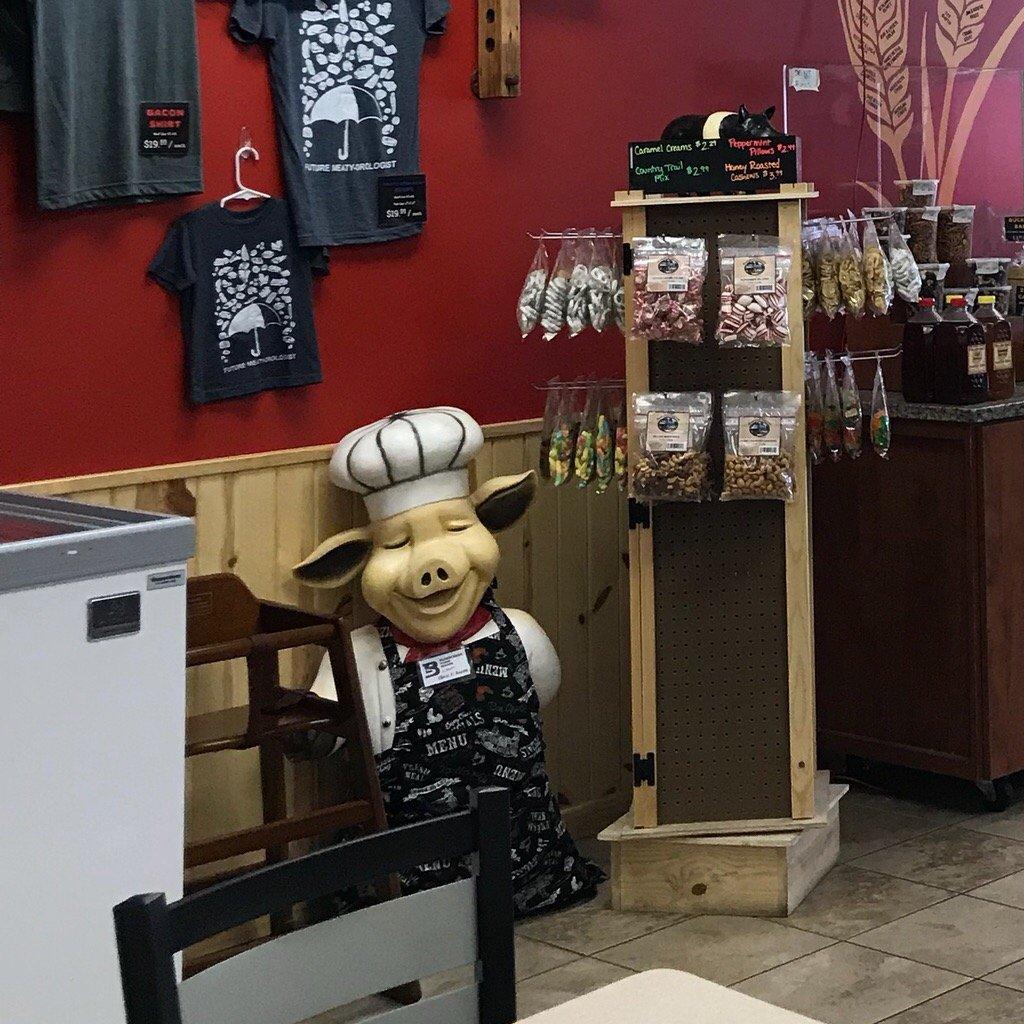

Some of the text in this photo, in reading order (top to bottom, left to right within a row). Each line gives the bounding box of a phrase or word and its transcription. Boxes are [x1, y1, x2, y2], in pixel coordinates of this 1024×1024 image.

[634, 144, 664, 155] Caramel
[666, 144, 692, 152] Creams
[728, 137, 772, 150] Peppermint
[305, 163, 331, 172] FUTURE
[635, 165, 664, 175] Country
[664, 161, 683, 172] Trail
[724, 158, 780, 174] Honey Roasted
[425, 733, 468, 757] MENU
